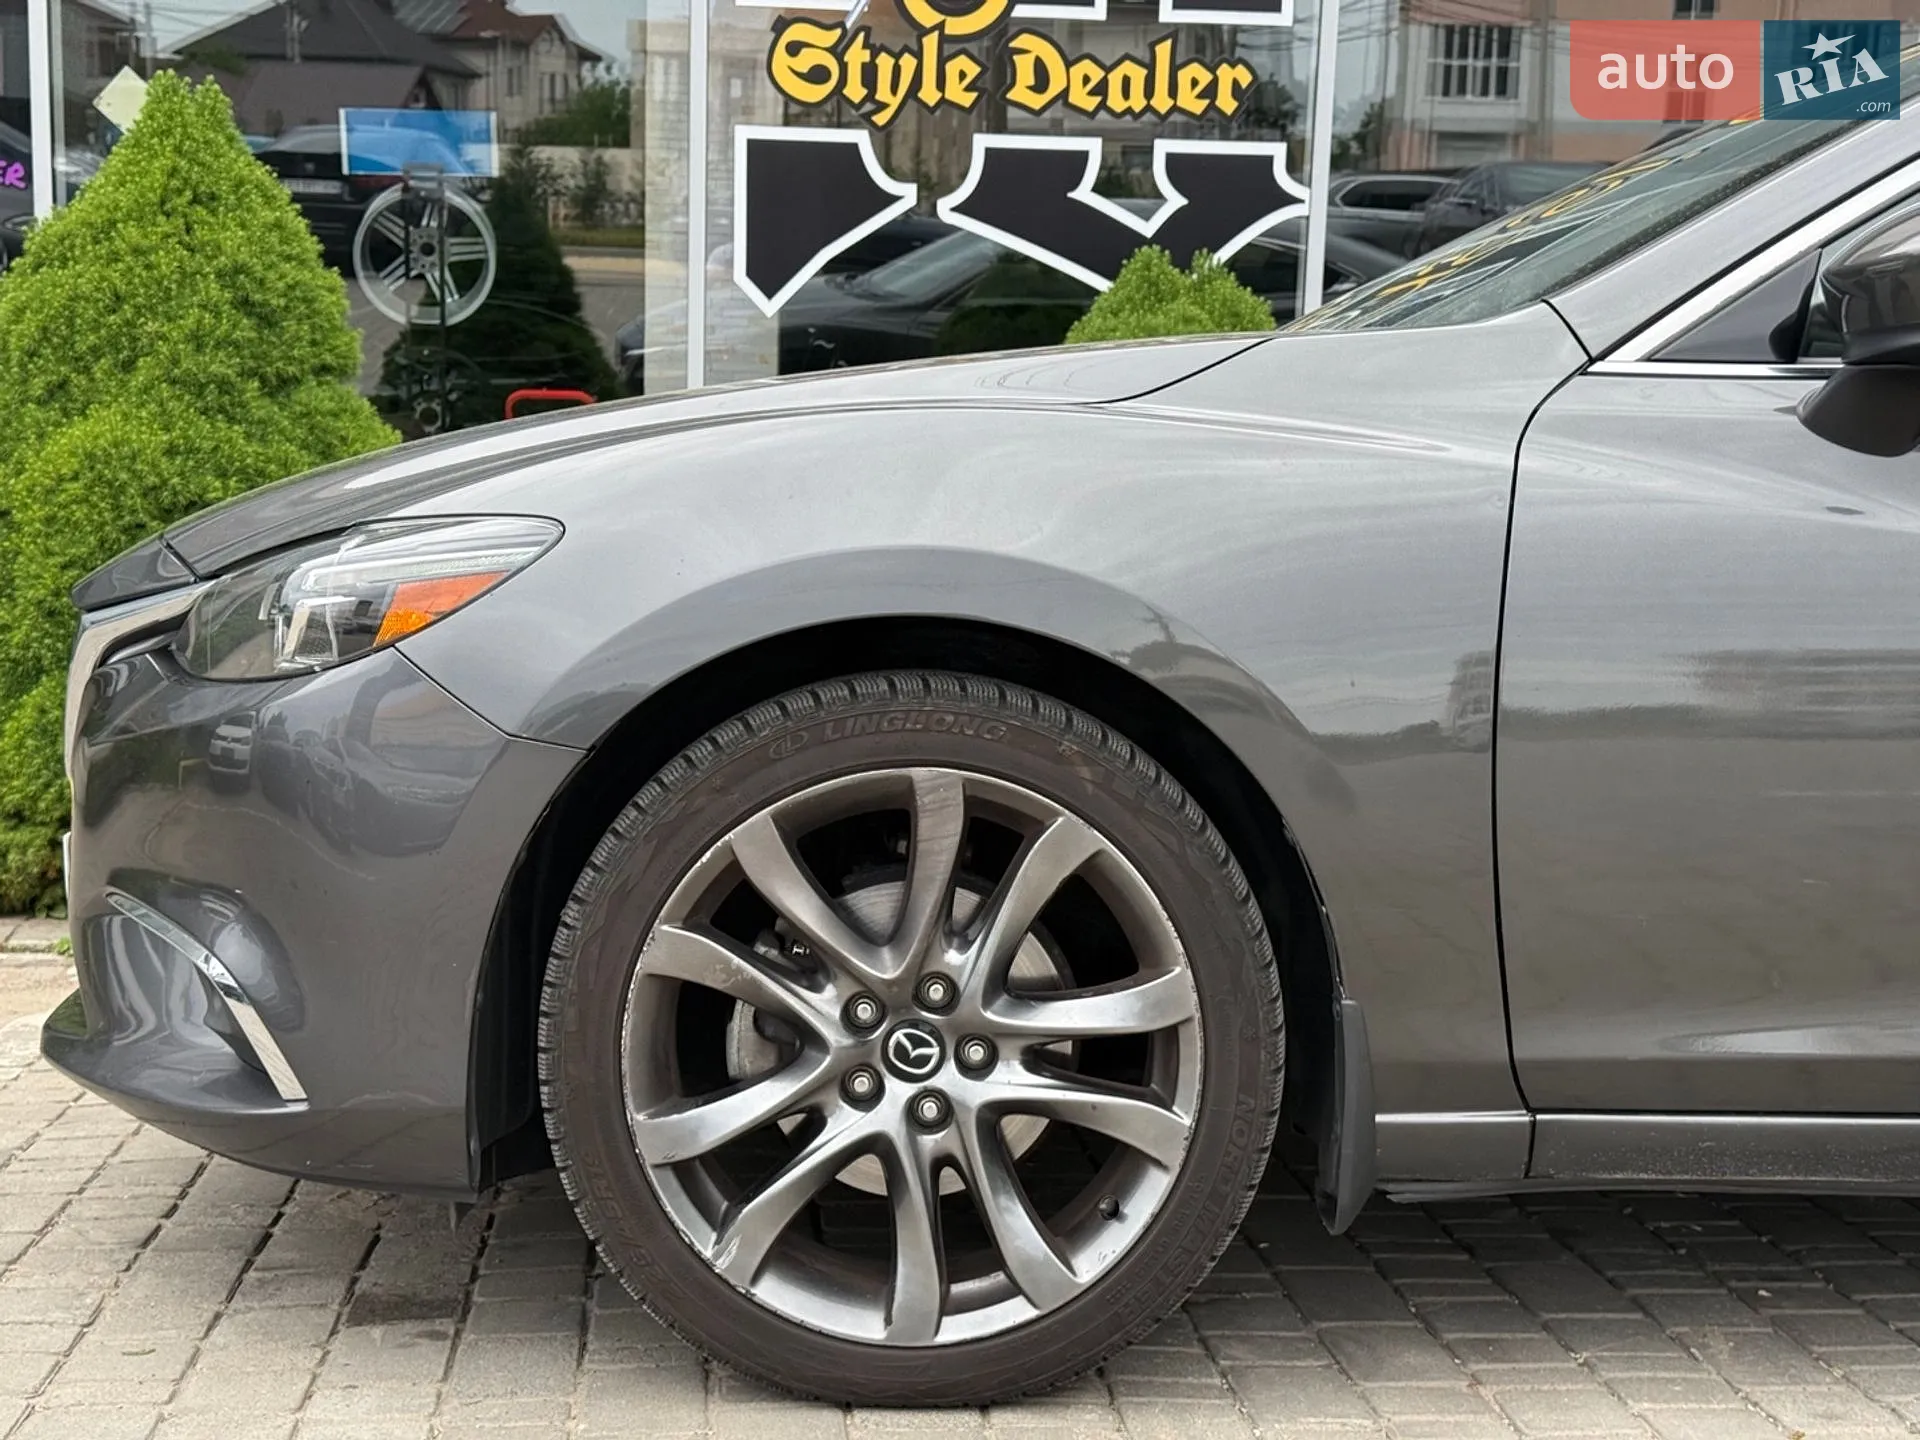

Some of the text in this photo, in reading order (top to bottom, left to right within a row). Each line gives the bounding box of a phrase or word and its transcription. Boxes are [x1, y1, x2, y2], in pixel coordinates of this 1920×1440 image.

[769, 20, 1256, 130] Style Dealer
[823, 711, 1008, 741] LINGLONG
